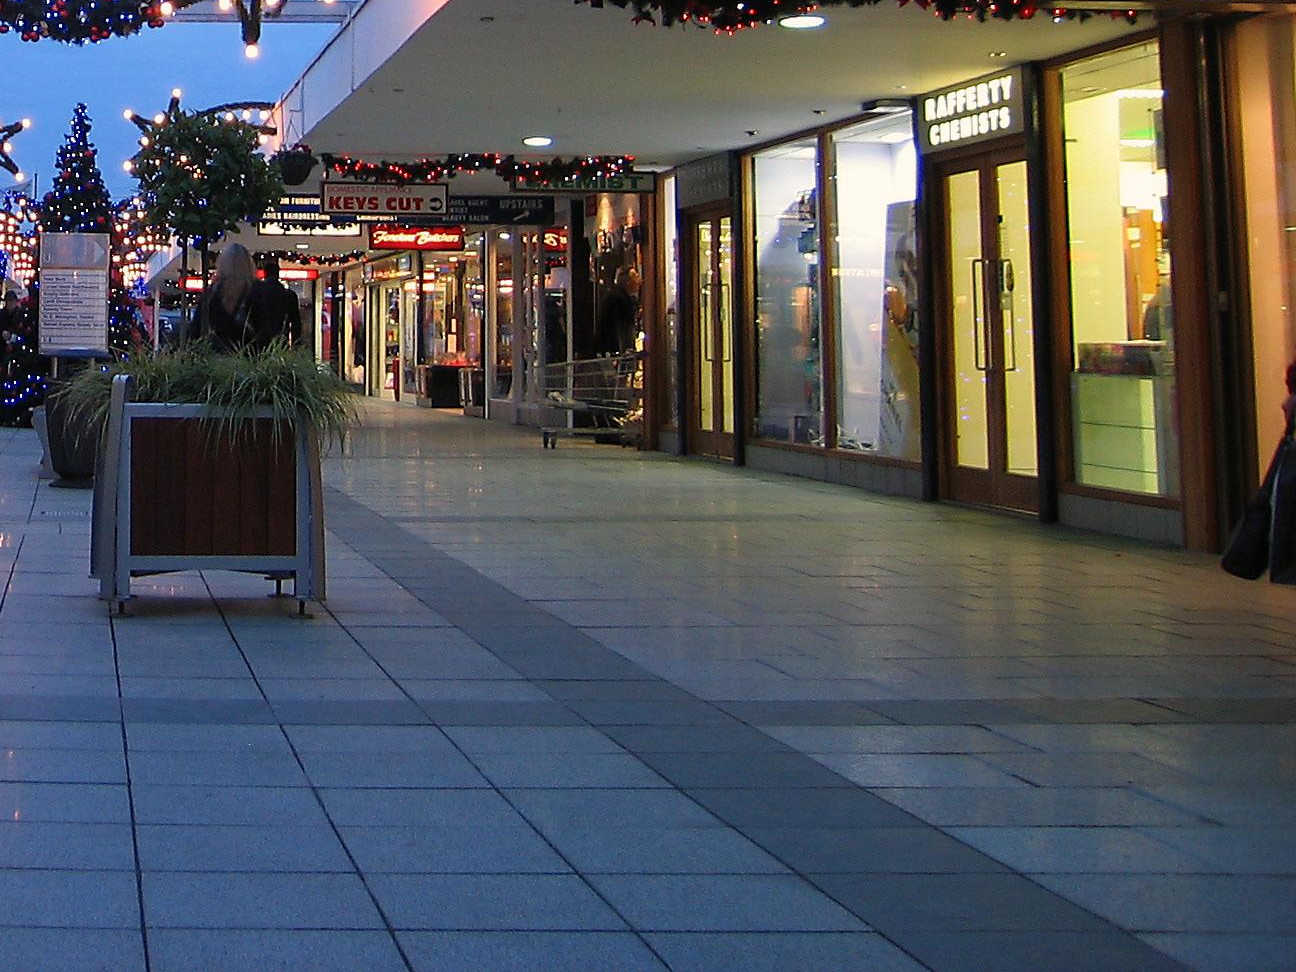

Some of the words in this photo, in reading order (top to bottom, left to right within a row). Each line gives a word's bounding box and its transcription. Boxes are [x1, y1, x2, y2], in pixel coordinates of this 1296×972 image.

[924, 75, 1013, 122] RAFFERTY
[929, 106, 1011, 146] CHEMISTS
[328, 196, 380, 211] KEYS
[385, 196, 424, 211] CUT
[499, 199, 544, 209] UPSTAIRS
